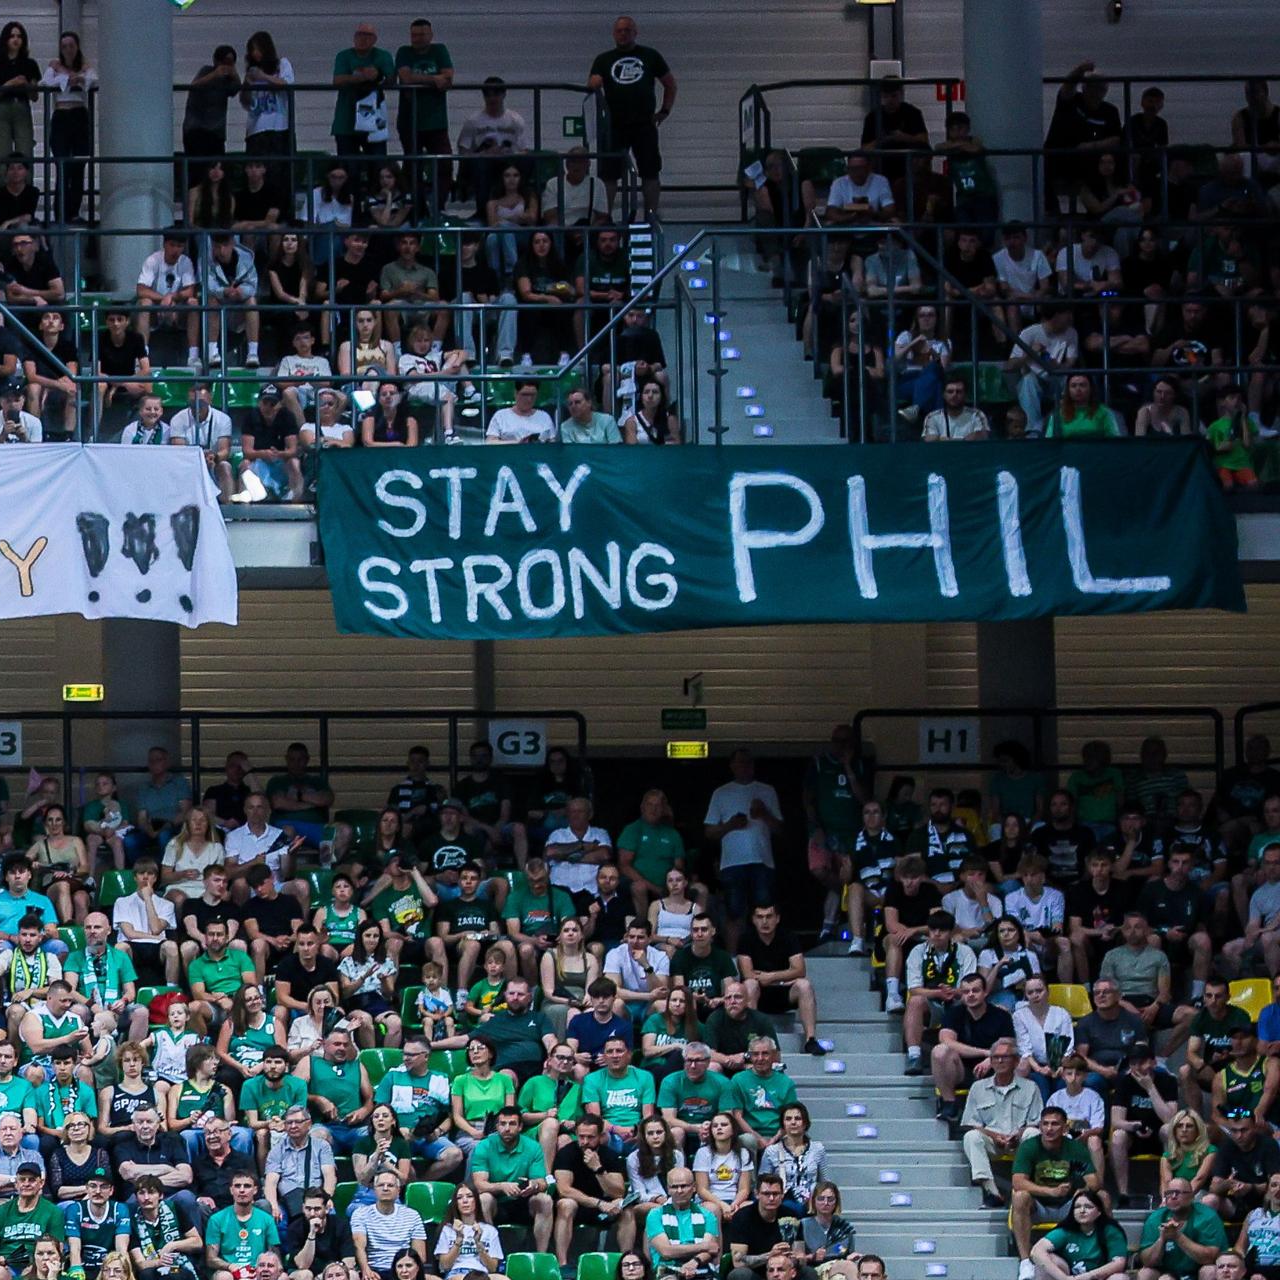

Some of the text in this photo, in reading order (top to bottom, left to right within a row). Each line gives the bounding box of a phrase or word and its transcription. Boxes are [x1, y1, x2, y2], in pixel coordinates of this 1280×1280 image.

[375, 464, 590, 539] STAY
[729, 467, 1168, 603] PHIL
[358, 542, 678, 623] STRONG
[496, 731, 541, 756] G3
[927, 729, 967, 753] H1
[2, 1223, 42, 1238] ZASTAL
